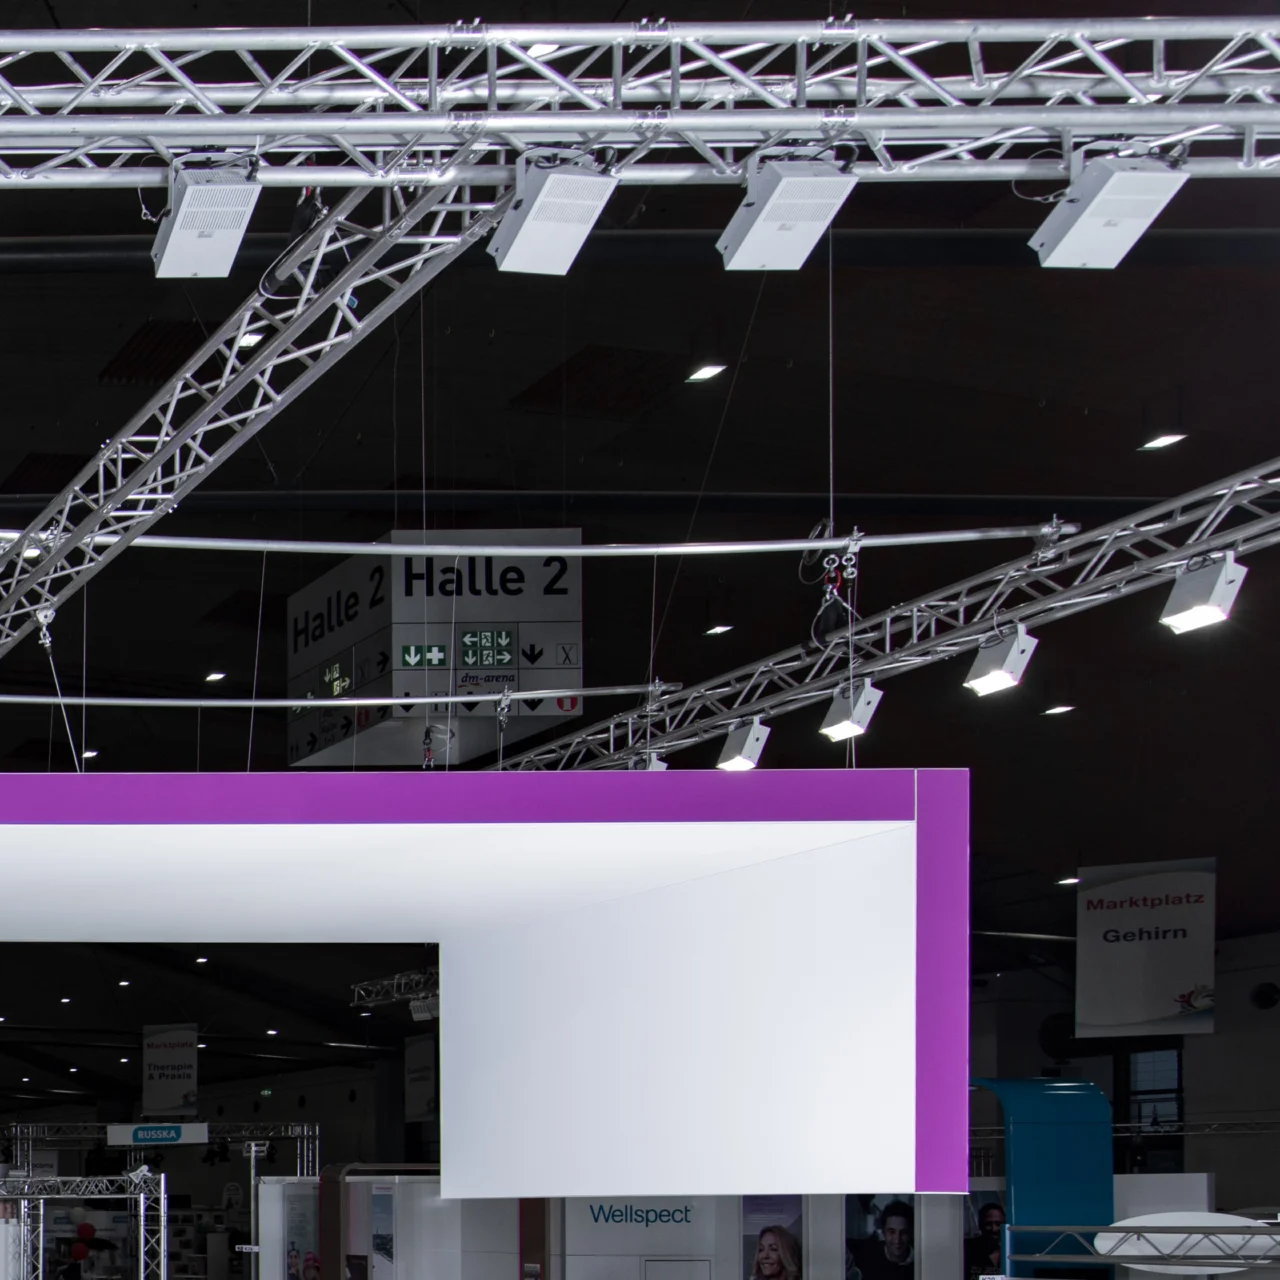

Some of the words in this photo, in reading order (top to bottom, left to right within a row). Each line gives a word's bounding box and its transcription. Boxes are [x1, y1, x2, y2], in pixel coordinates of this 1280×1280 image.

[405, 556, 526, 597] Halle
[542, 555, 569, 596] 2
[292, 590, 360, 654] Halle
[369, 565, 385, 610] 2
[461, 672, 516, 684] dm-arena
[1086, 893, 1205, 911] Marktplatz
[1102, 926, 1188, 943] Gehirn
[146, 1040, 194, 1050] Marktplatz
[147, 1062, 194, 1072] Therapie
[158, 1071, 193, 1081] Praxis
[137, 1129, 178, 1141] RUSSKA
[589, 1204, 692, 1228] Wellspect
